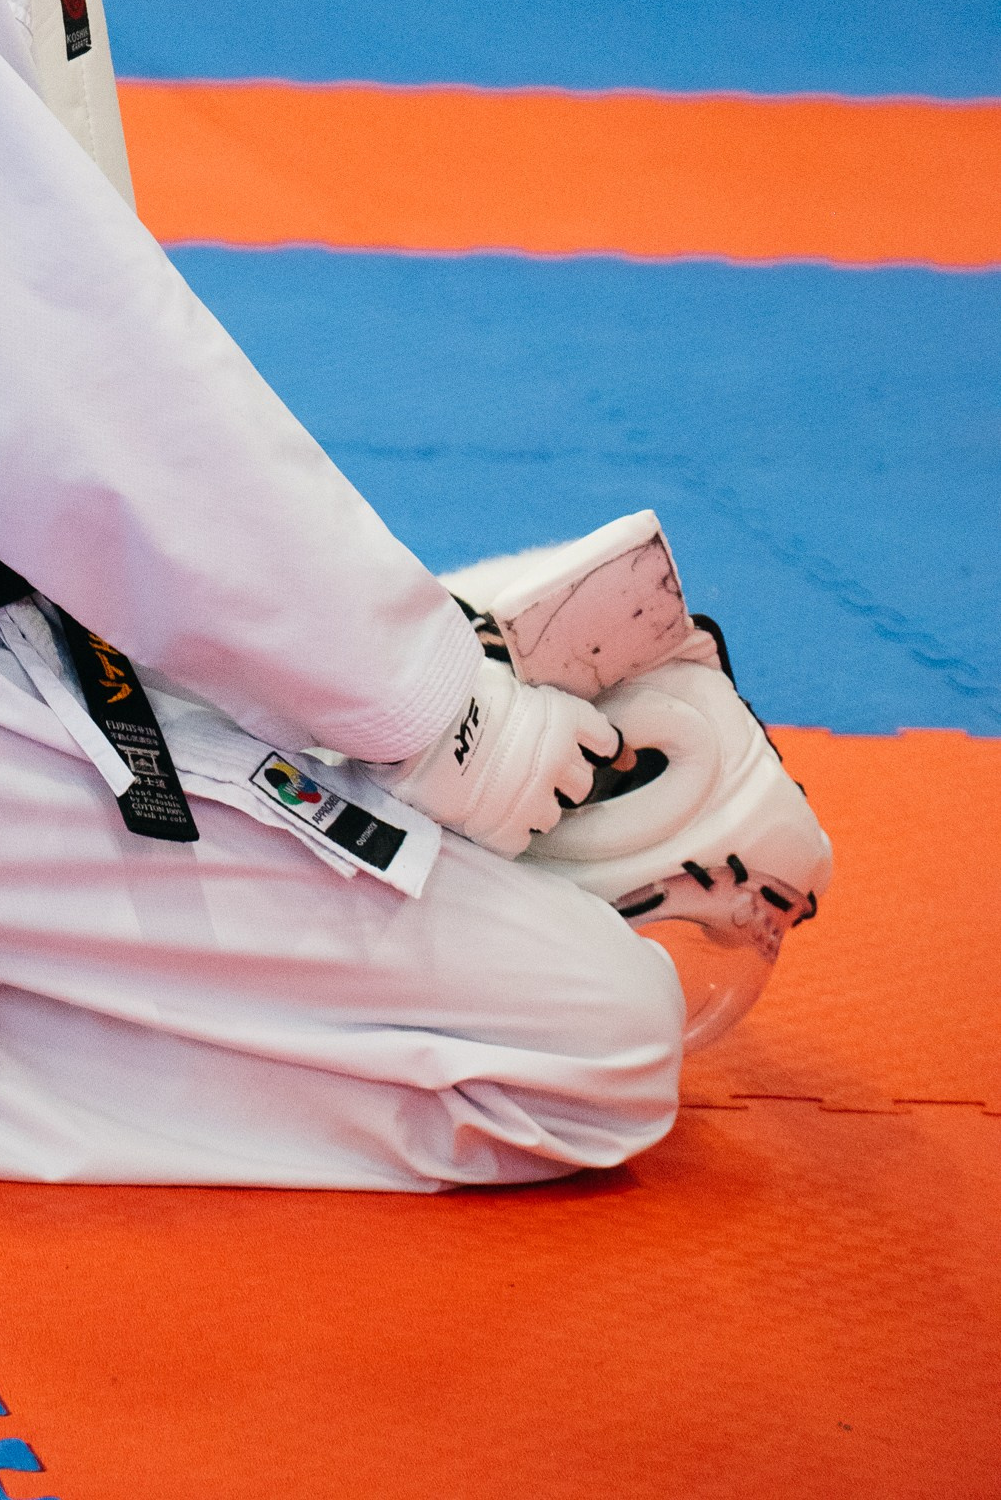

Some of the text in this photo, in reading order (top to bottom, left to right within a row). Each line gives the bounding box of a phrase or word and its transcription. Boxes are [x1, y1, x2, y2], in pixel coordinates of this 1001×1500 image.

[454, 697, 479, 766] WTF
[132, 803, 164, 812] COTTON
[135, 810, 156, 819] Wash
